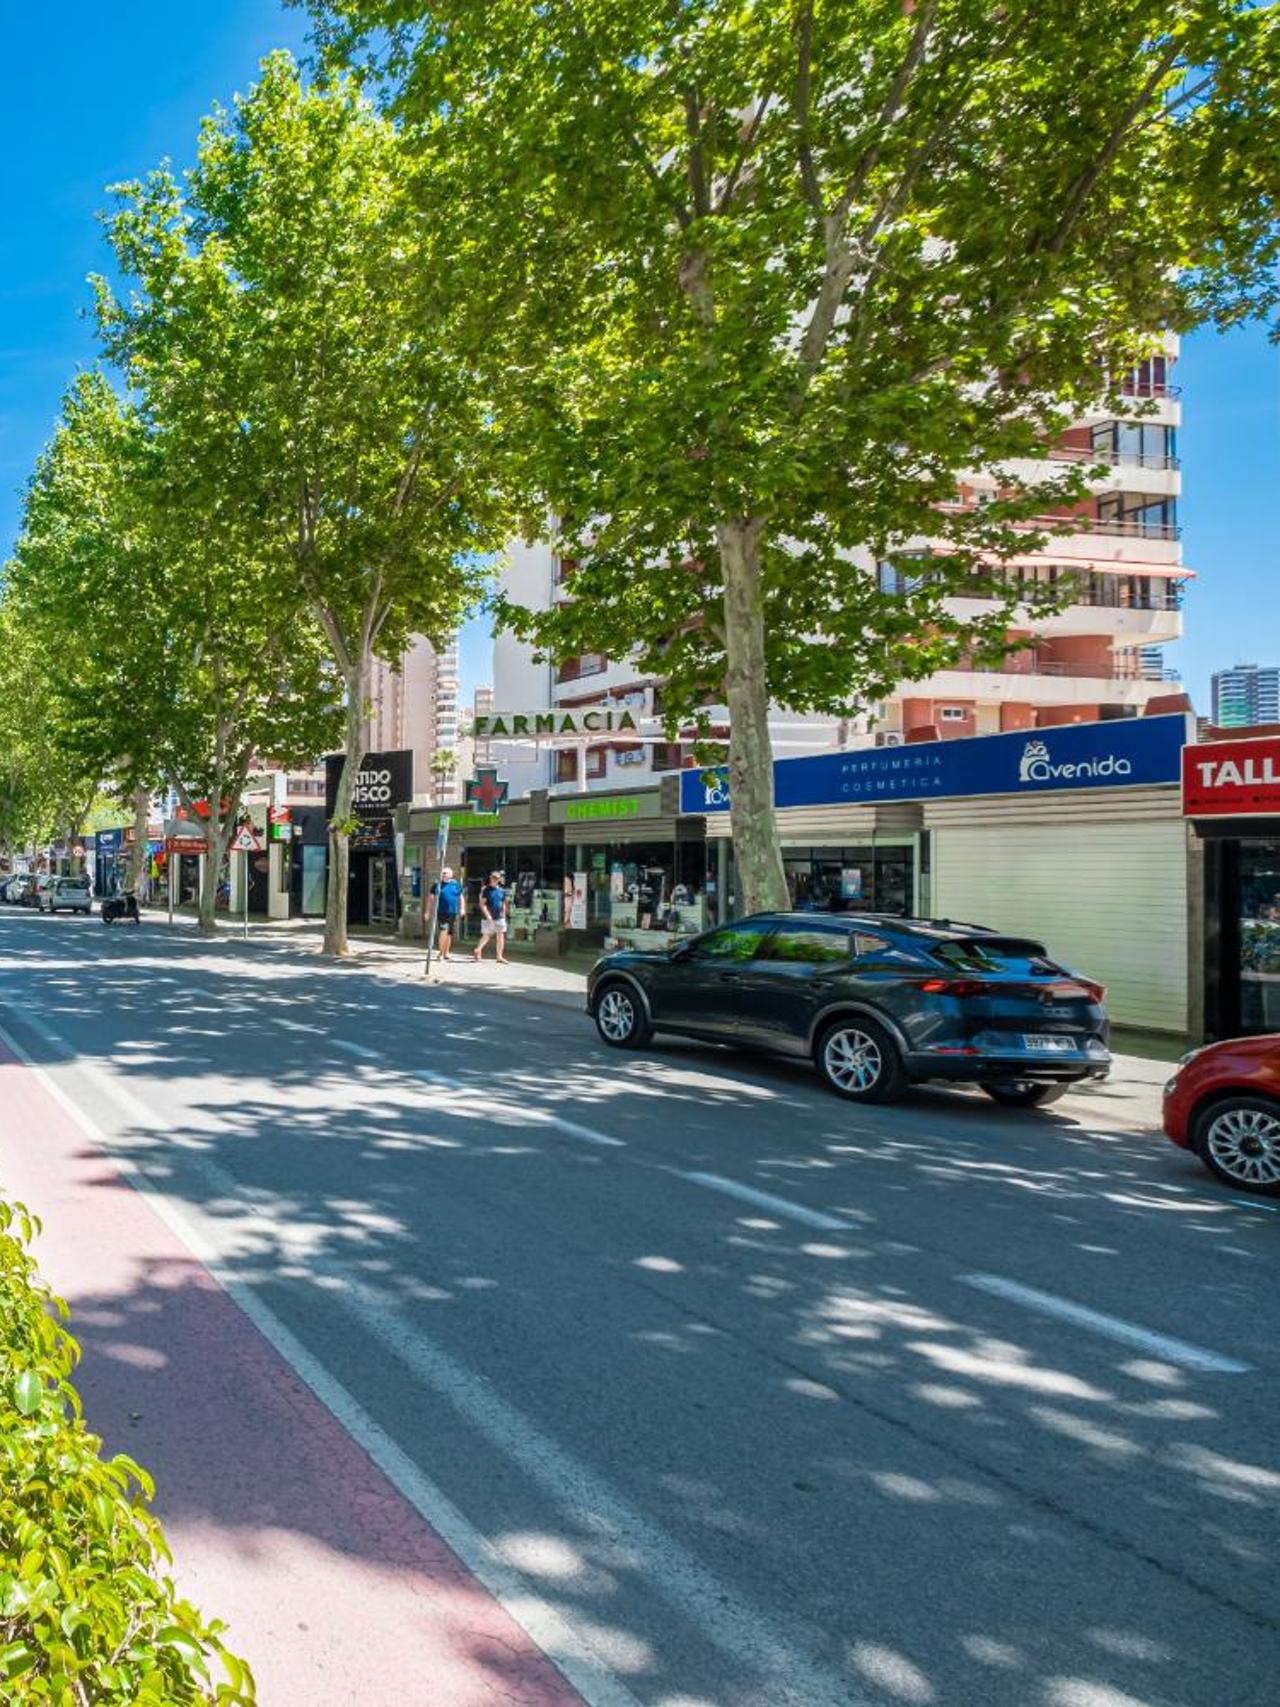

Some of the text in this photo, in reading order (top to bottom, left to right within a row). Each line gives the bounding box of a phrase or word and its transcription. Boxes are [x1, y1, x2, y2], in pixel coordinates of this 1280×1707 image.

[475, 710, 637, 735] FARMACIA
[356, 769, 392, 785] TIDO
[1197, 757, 1280, 788] TALL
[352, 785, 392, 802] ISCO
